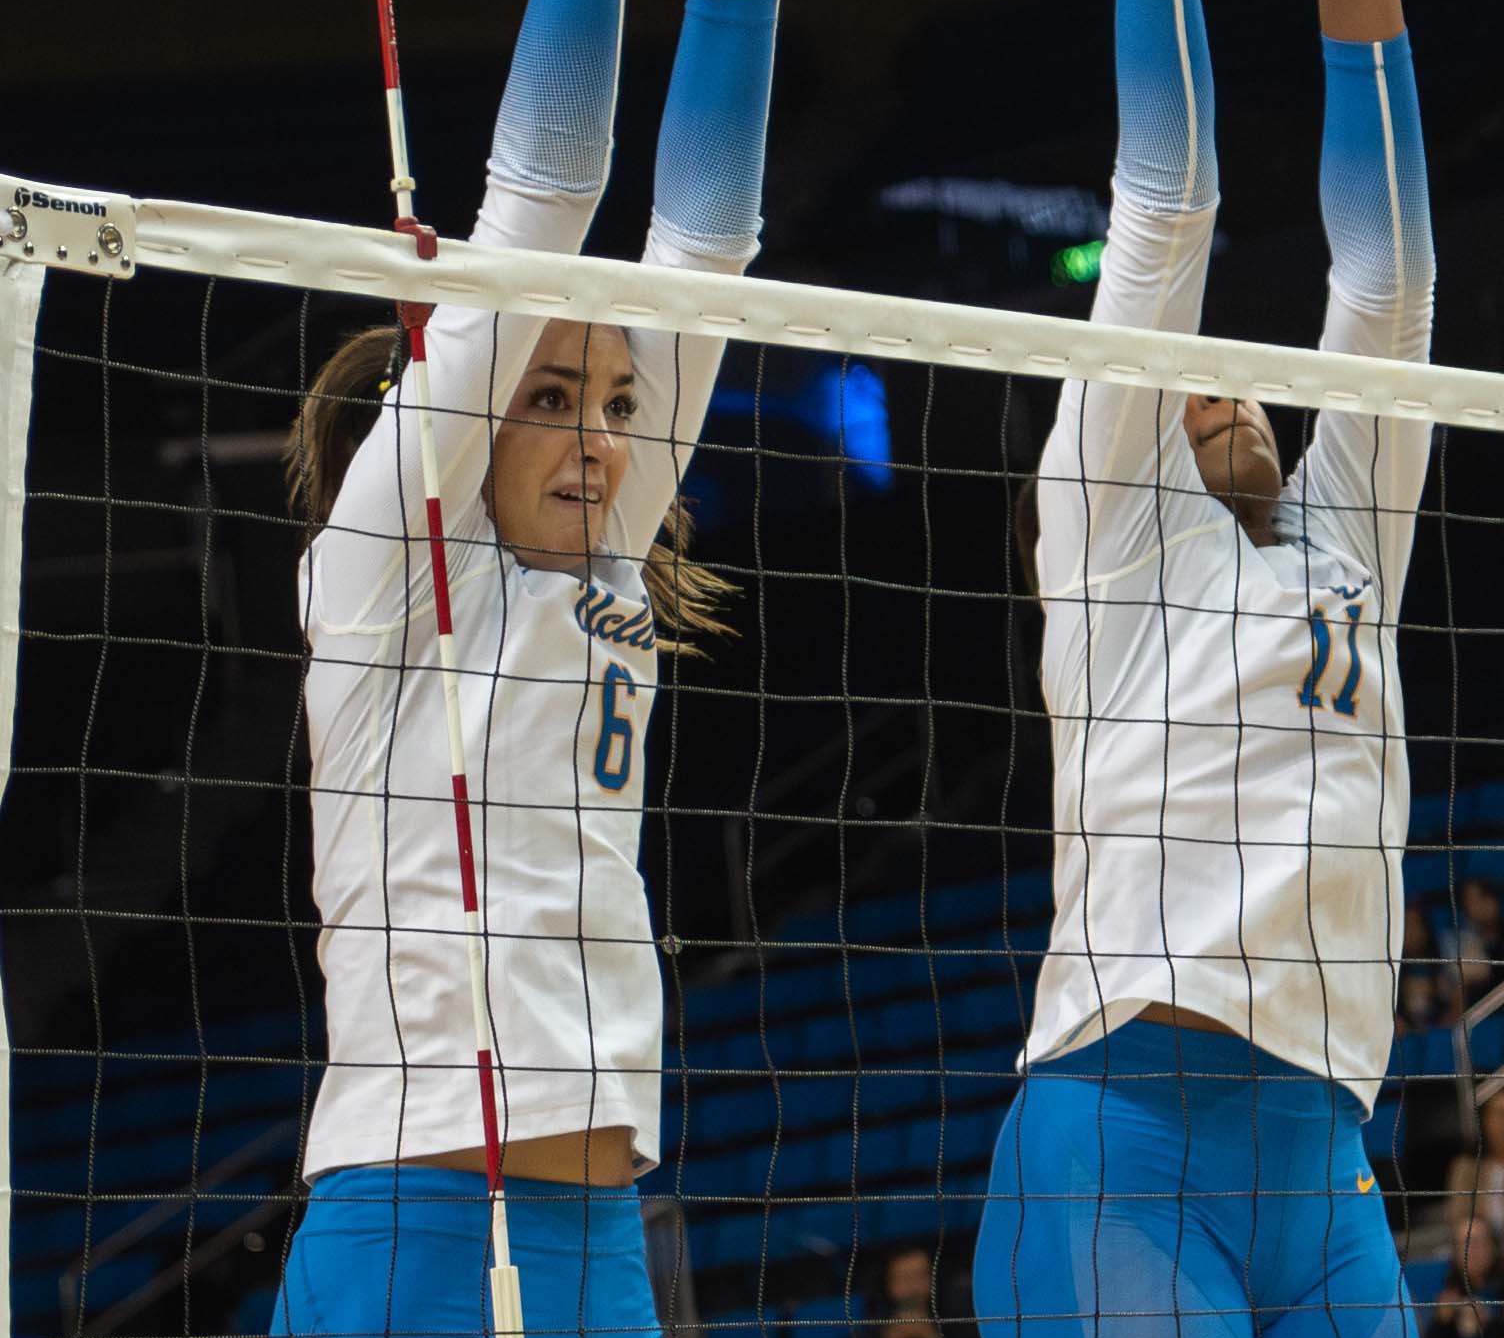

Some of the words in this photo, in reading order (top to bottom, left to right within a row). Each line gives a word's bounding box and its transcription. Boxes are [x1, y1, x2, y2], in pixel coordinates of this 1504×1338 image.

[32, 191, 107, 217] Senoh
[1297, 602, 1364, 720] 11
[592, 659, 637, 795] 6
